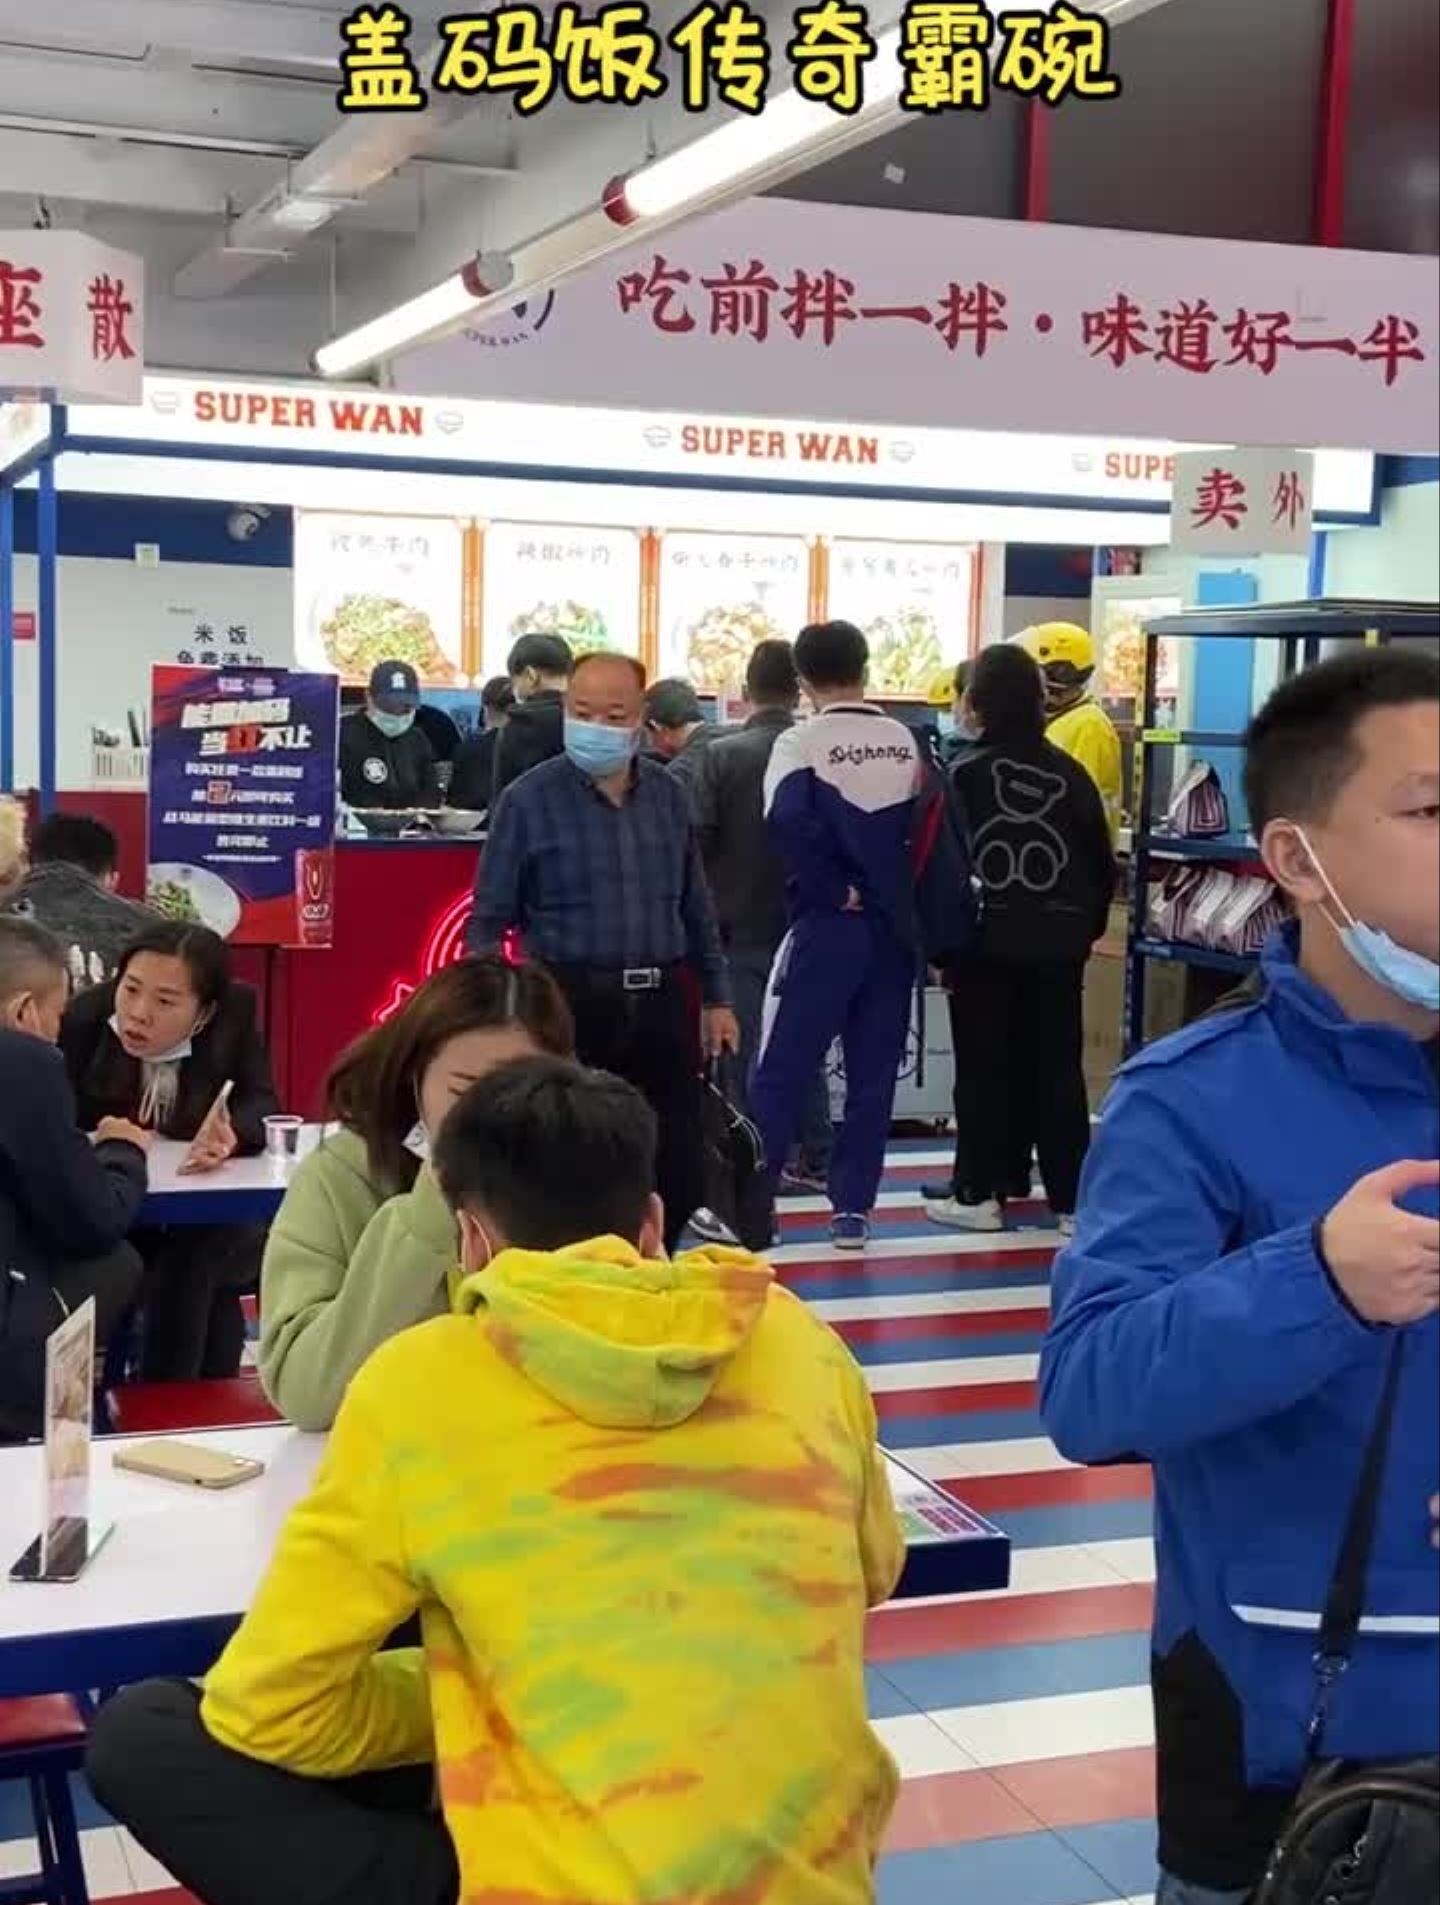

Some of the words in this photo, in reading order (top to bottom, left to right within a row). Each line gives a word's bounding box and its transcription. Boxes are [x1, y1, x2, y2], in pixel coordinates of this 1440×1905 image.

[87, 272, 136, 362] 散
[194, 391, 316, 427] SUPER
[329, 400, 424, 436] WAN
[681, 424, 786, 459] SUPER
[796, 432, 879, 464] WAN
[1271, 470, 1304, 531] 外
